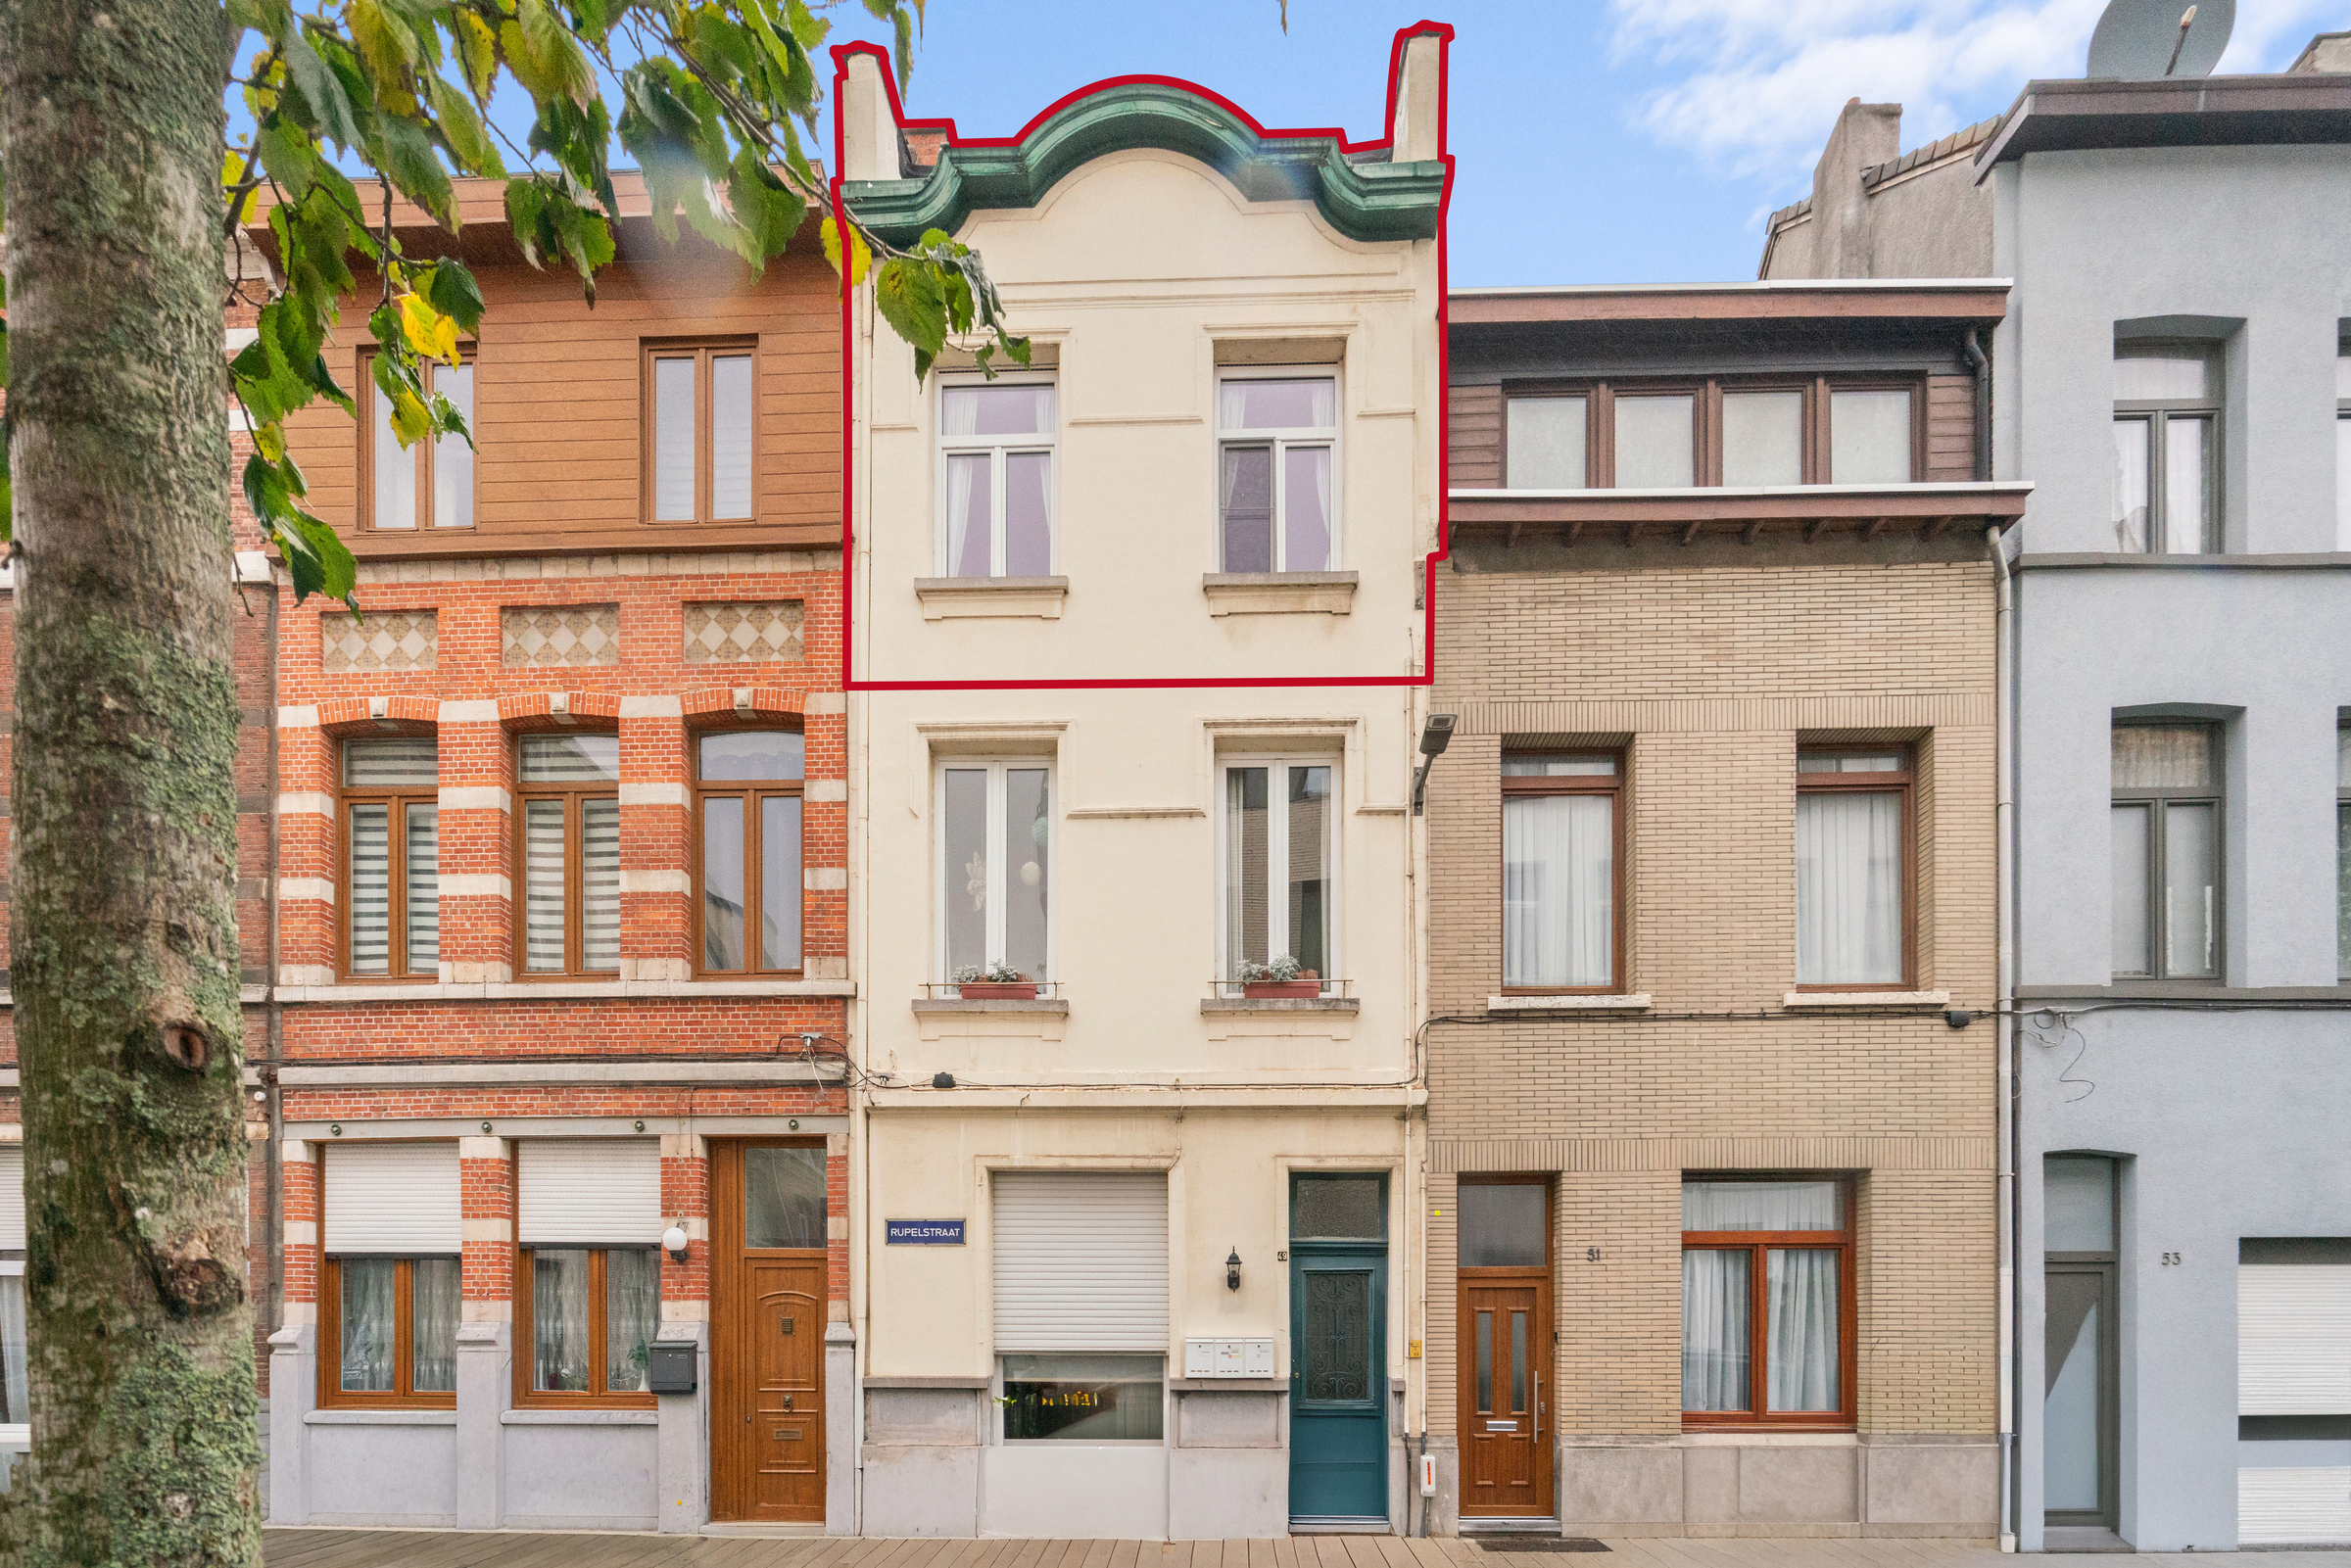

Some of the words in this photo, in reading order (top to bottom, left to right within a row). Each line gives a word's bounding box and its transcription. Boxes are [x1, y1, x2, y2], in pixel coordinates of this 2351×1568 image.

[890, 1228, 960, 1237] RUPELSTRAAT
[1278, 1252, 1287, 1260] 49
[1587, 1248, 1600, 1261] 51
[2161, 1252, 2181, 1265] 53
